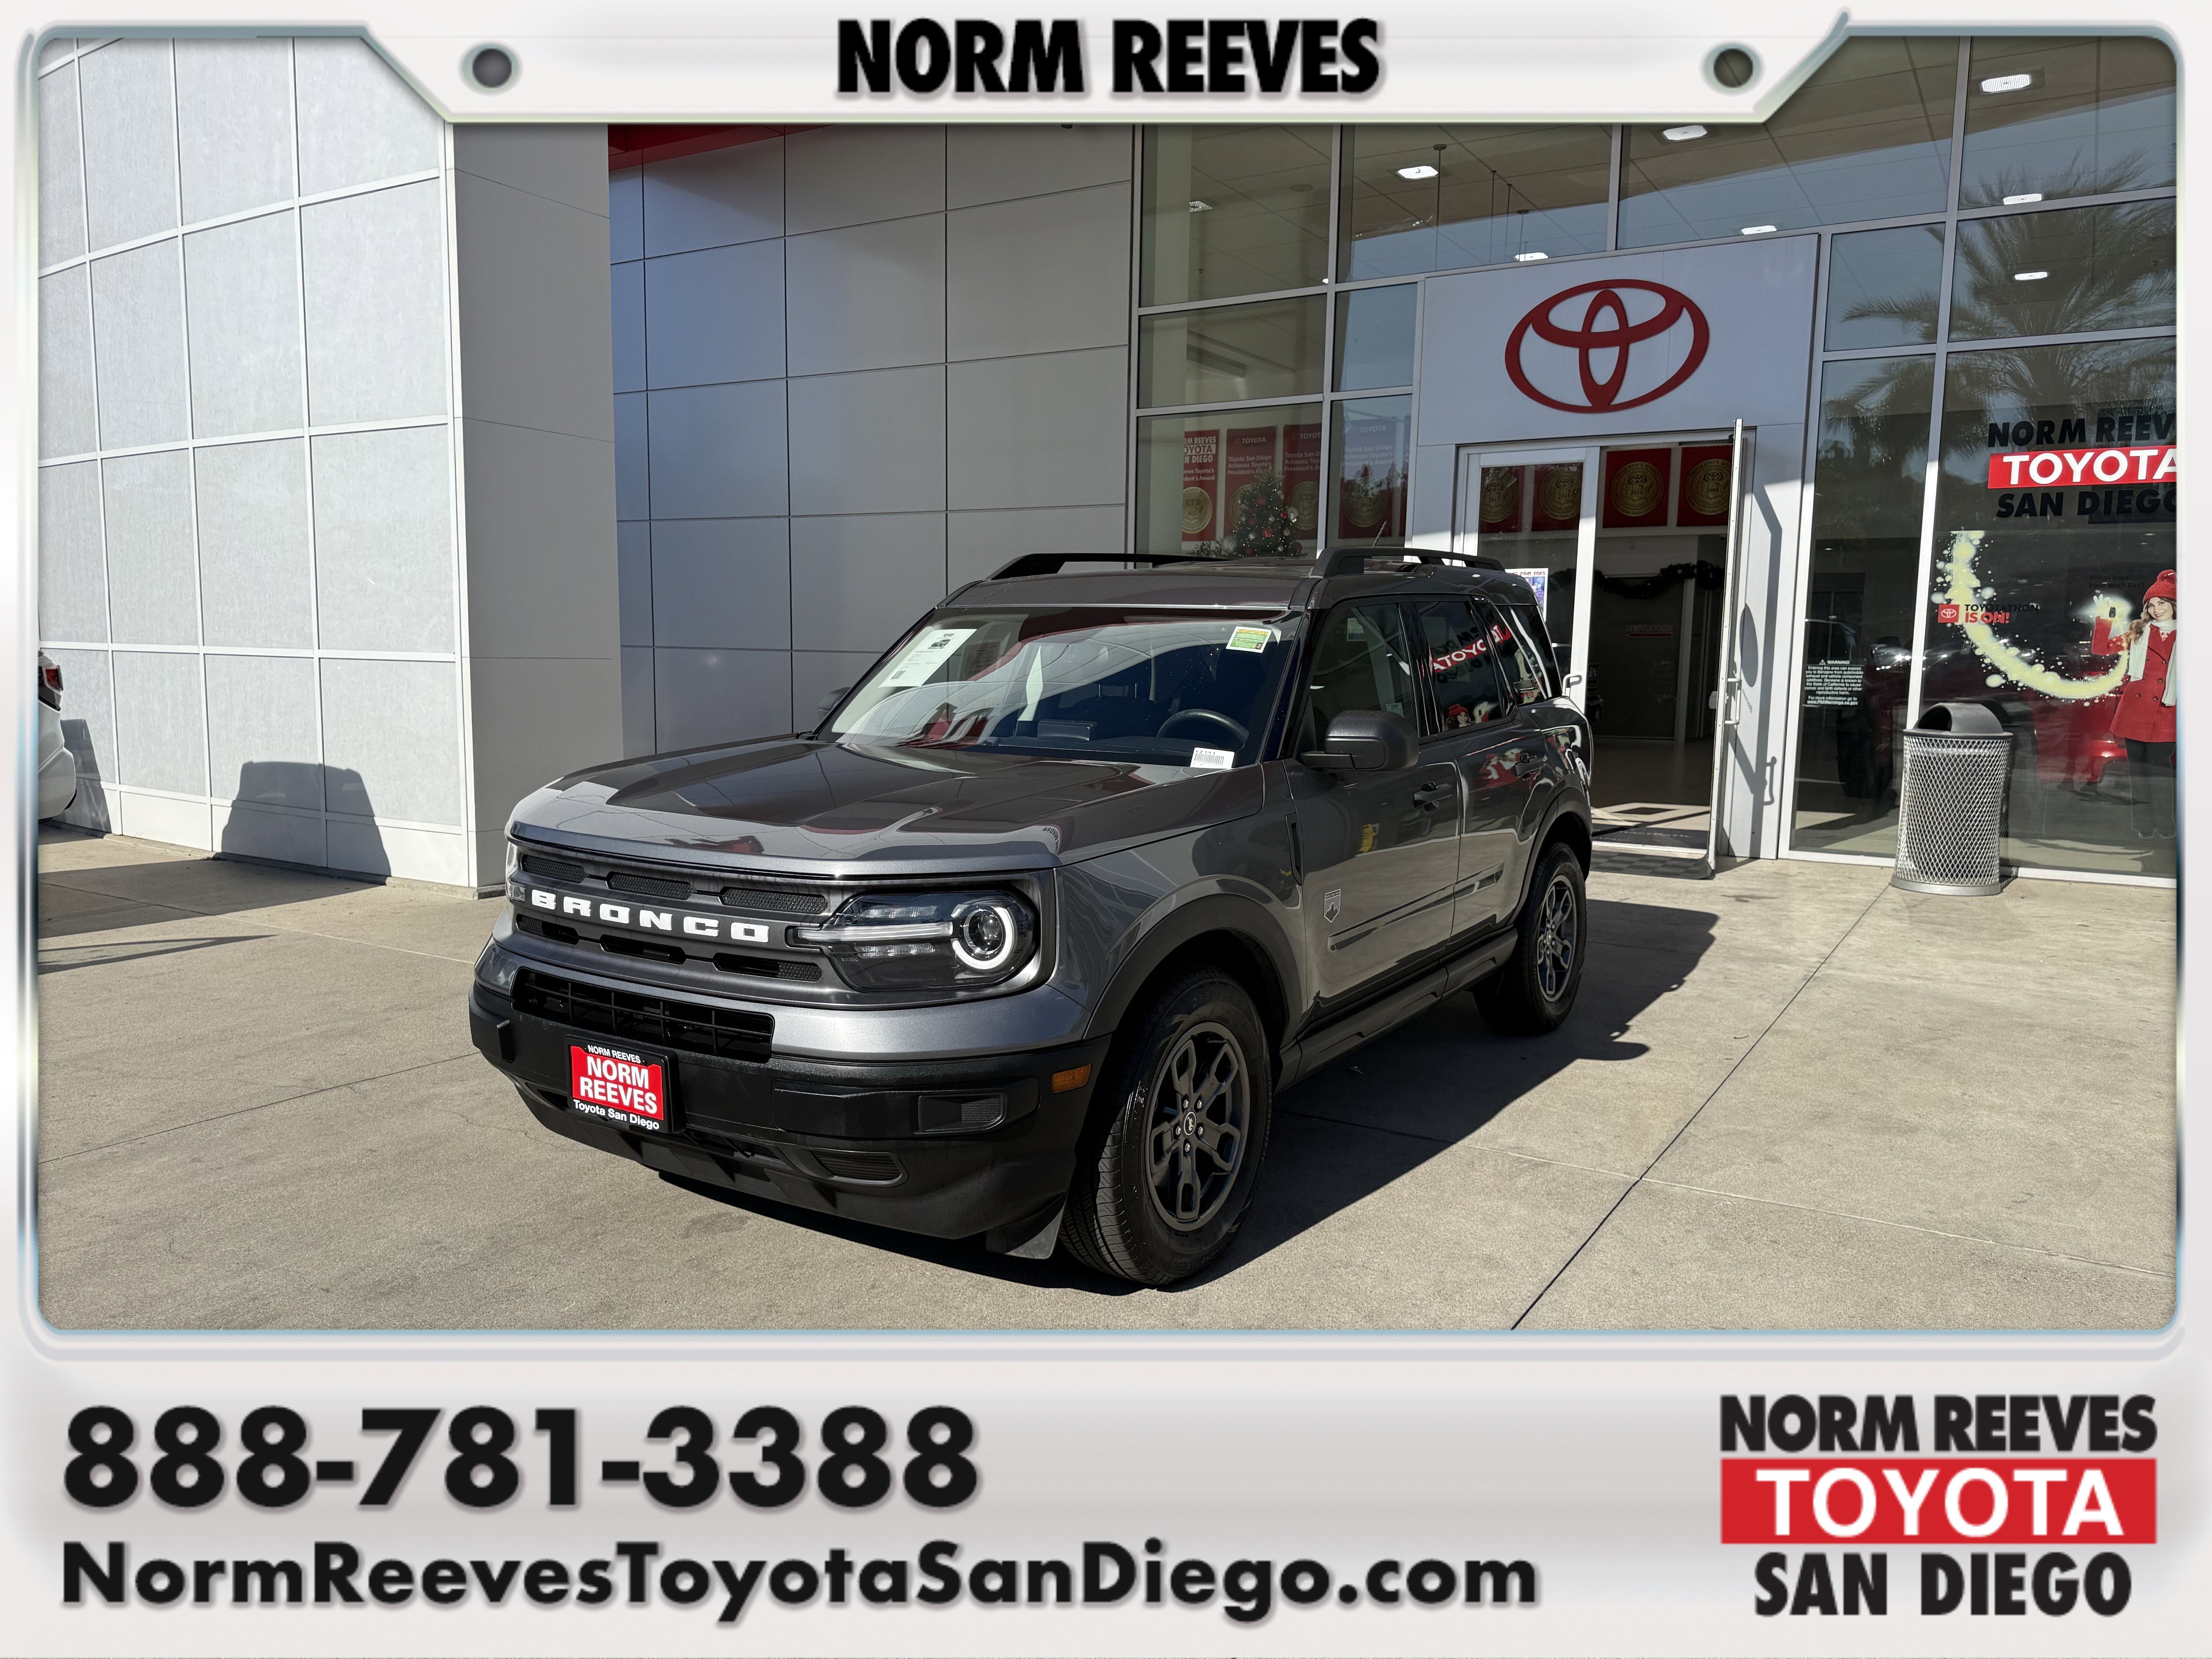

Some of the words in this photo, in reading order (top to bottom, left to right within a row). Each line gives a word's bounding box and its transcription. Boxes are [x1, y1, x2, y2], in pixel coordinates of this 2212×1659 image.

[1987, 418, 2086, 447] NORM
[2003, 449, 2177, 485] TOYOTA
[1996, 492, 2064, 518] SAN
[1965, 612, 1978, 623] IS
[1980, 612, 2010, 624] ON!
[532, 890, 769, 943] BRONCO
[587, 1044, 610, 1057] NORM
[612, 1049, 641, 1064] REEVES
[587, 1055, 649, 1090] NORM
[580, 1076, 657, 1115] REEVES
[573, 1099, 606, 1116] Toyota
[608, 1108, 627, 1121] San
[630, 1113, 659, 1130] Diego
